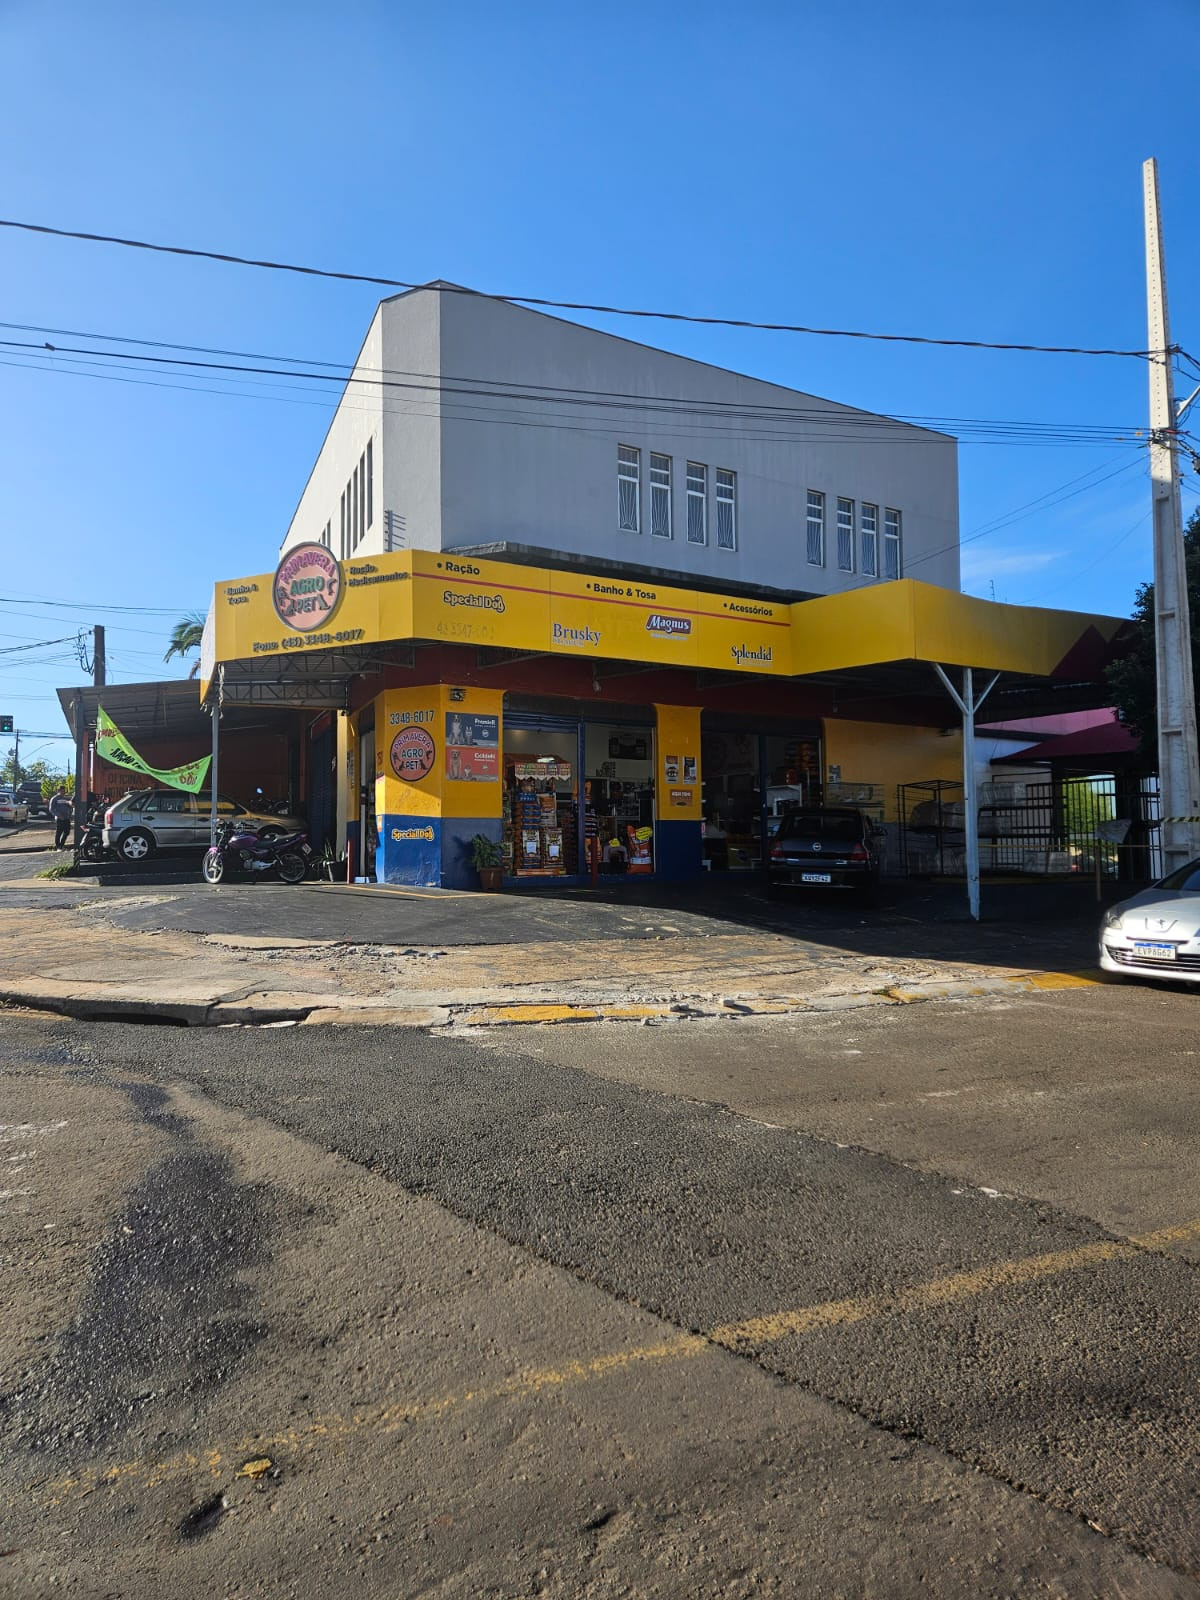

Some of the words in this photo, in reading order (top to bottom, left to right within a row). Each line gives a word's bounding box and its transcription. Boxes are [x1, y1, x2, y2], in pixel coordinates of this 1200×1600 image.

[279, 552, 335, 585] PRIMAVERA
[445, 561, 480, 576] Ração
[291, 576, 324, 596] AGRO
[593, 583, 624, 597] Banho
[626, 587, 633, 597] &
[635, 588, 656, 600] Tosa
[297, 597, 317, 613] PET
[443, 590, 483, 608] Special
[483, 594, 506, 613] Dog
[729, 602, 773, 617] Acessórios
[647, 616, 690, 633] Magnus
[305, 628, 365, 645] 3348-6017
[553, 623, 601, 647] Brusky
[731, 644, 773, 666] Splendid
[390, 710, 434, 725] 3348-6017
[394, 733, 432, 750] PRIMAVERA
[402, 748, 424, 758] AGRO
[405, 760, 418, 770] PET
[392, 828, 418, 842] Special
[418, 826, 433, 841] Dog
